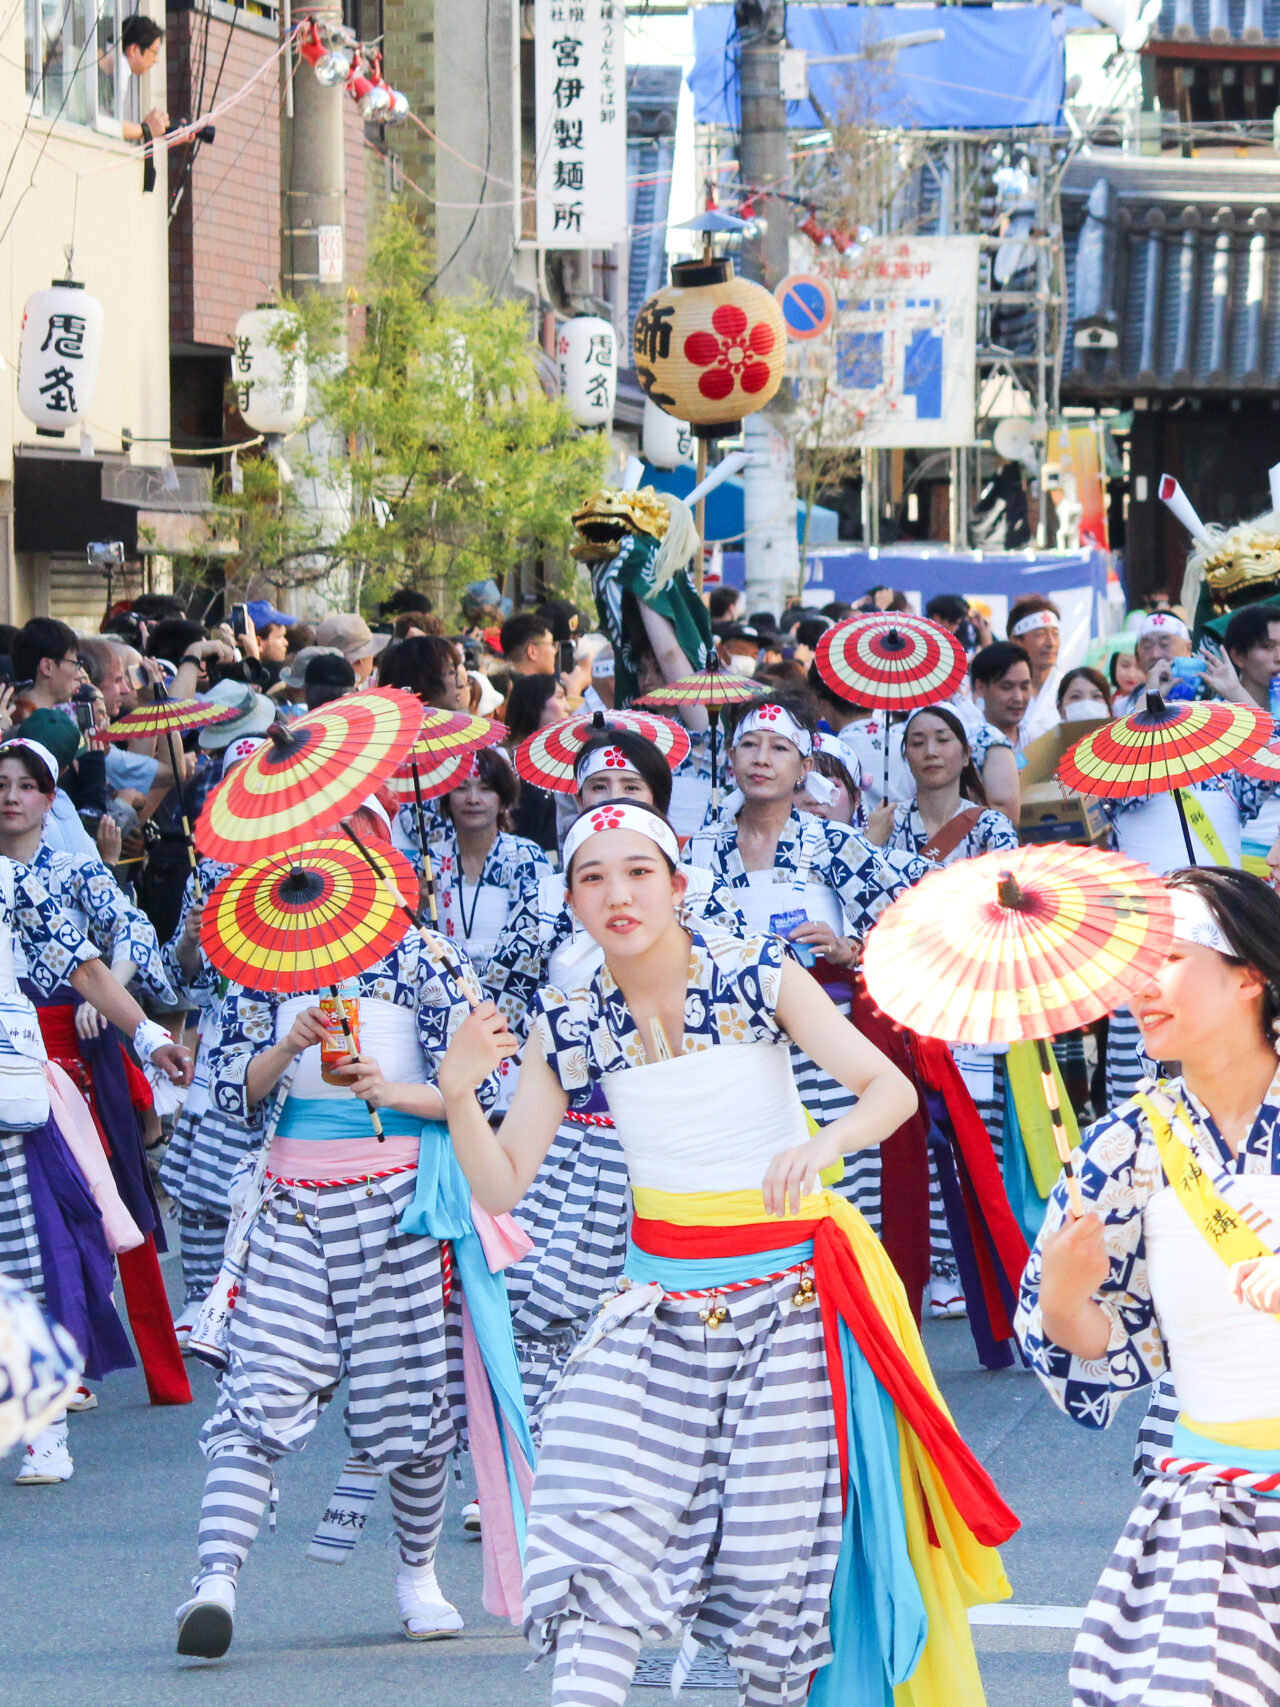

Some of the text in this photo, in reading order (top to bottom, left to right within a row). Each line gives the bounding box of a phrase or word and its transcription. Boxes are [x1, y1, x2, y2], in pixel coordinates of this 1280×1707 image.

[552, 35, 584, 232] 宮伊製麺所
[599, 0, 615, 124] 種うどんそば卸
